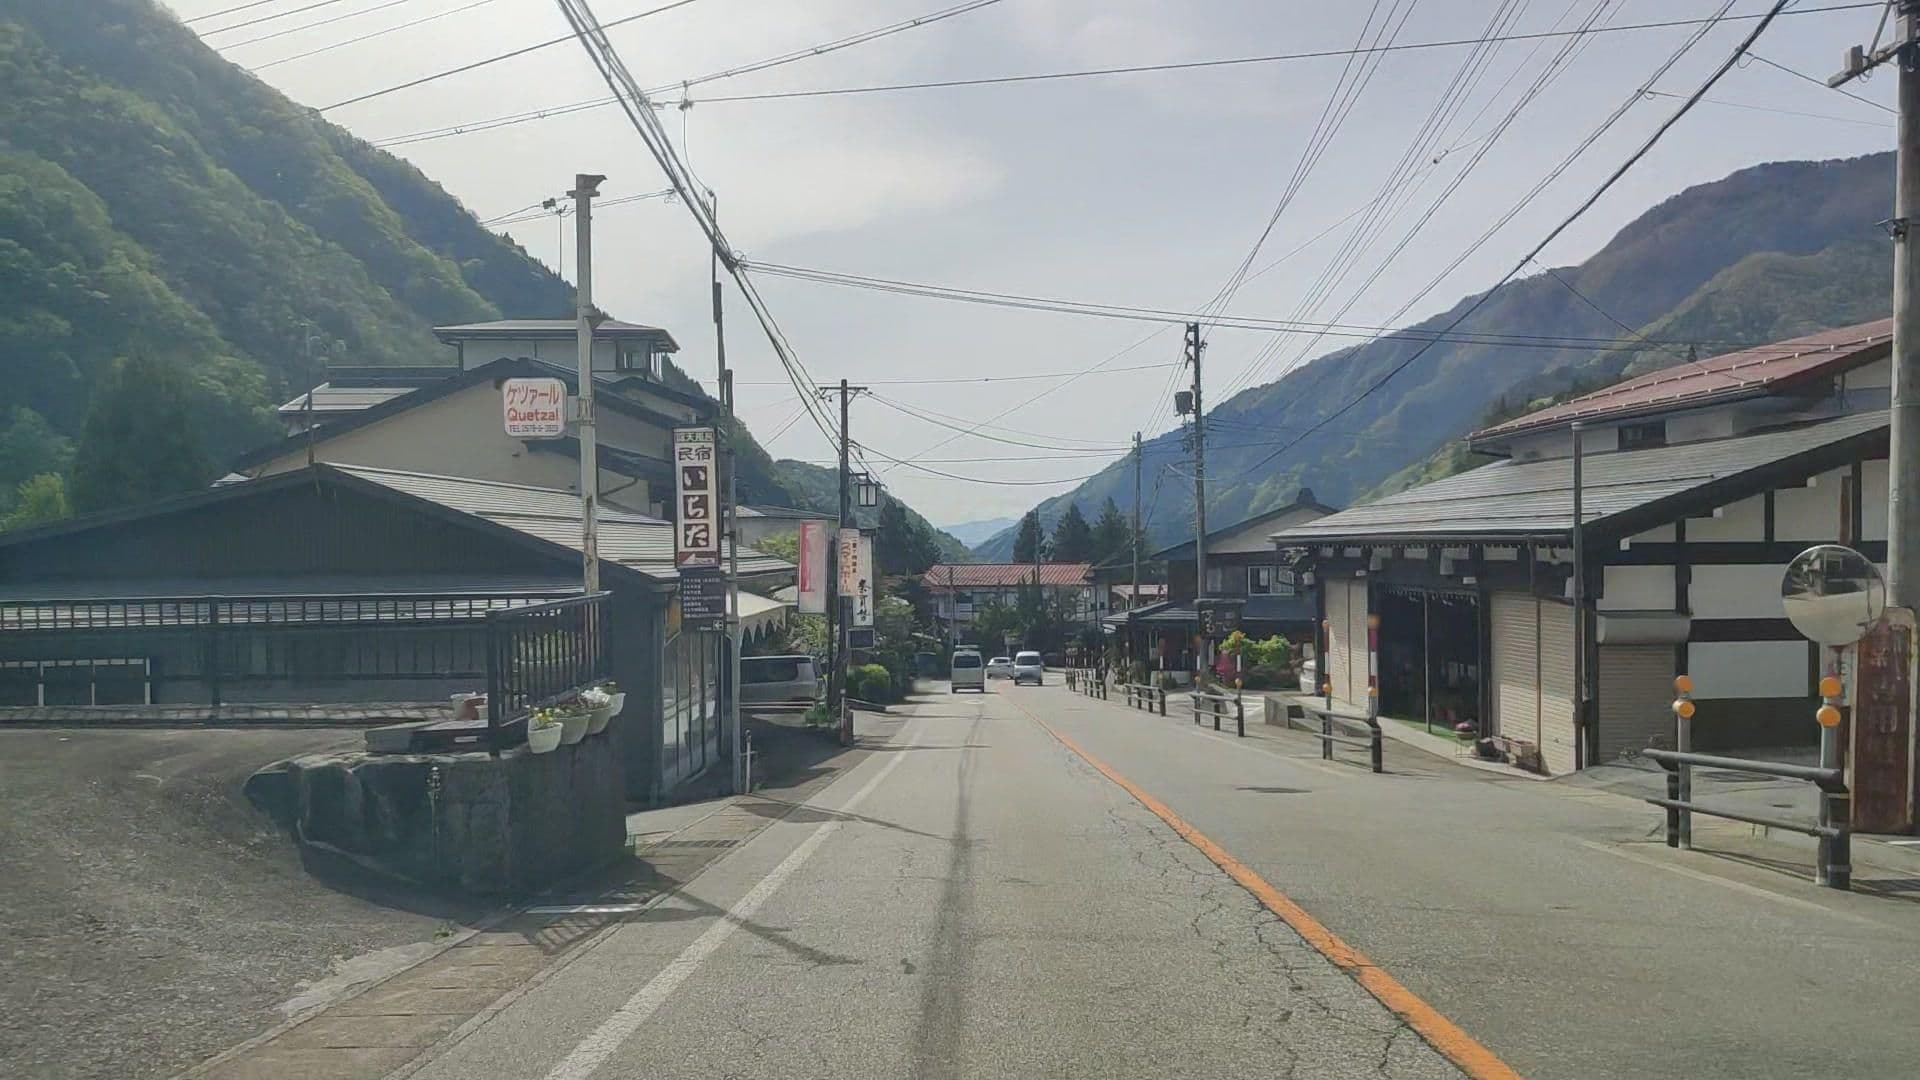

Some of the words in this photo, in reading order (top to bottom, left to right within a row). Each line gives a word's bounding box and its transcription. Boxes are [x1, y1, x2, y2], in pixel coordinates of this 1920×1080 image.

[506, 384, 560, 406] ケツァール
[507, 408, 560, 422] Quetzal
[679, 445, 712, 461] 民宿
[683, 466, 708, 547] いちた
